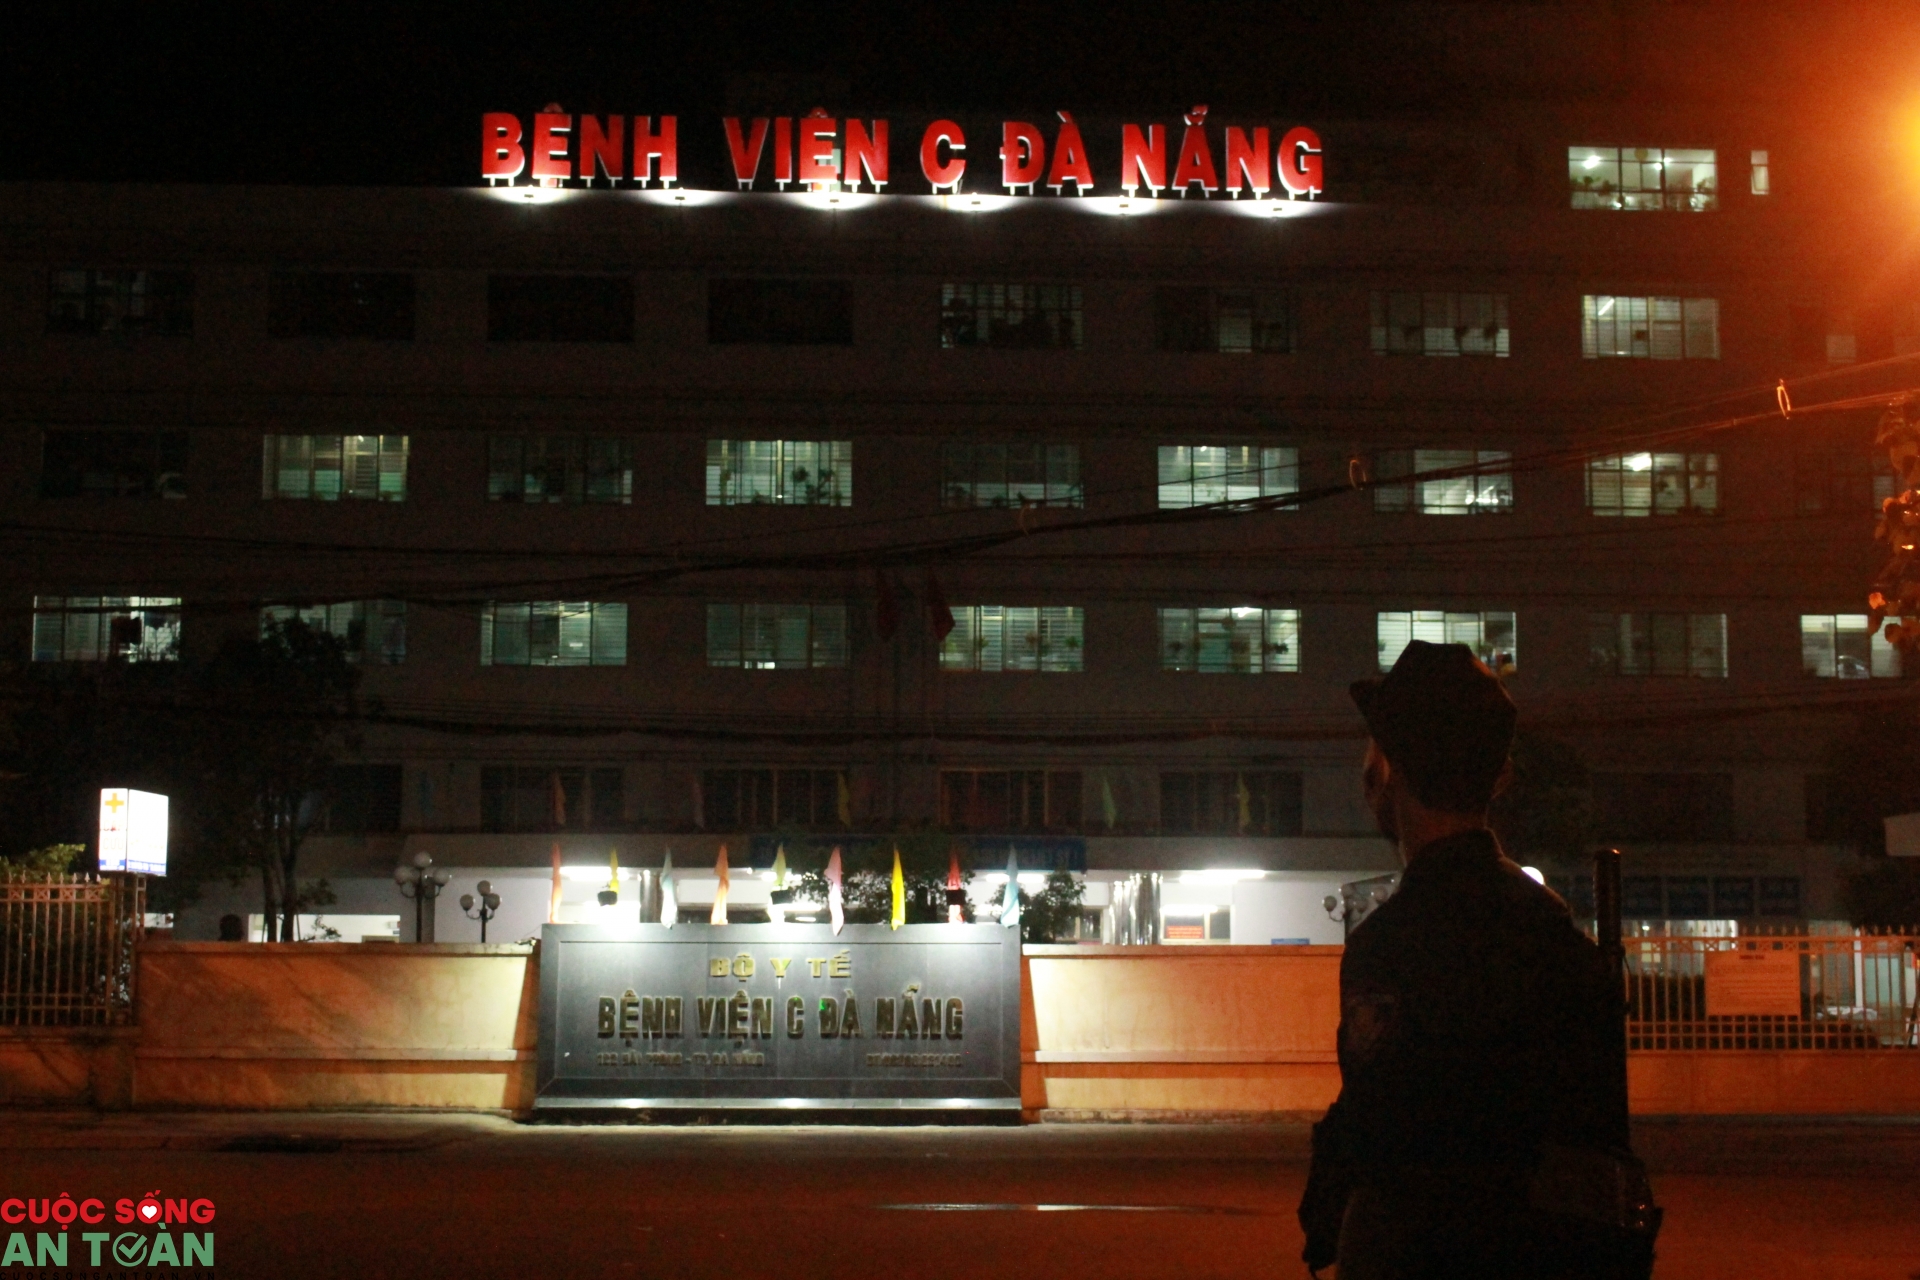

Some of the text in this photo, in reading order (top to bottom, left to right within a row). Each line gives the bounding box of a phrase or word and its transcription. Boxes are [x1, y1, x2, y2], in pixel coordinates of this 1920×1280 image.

[920, 119, 967, 189] C
[999, 111, 1094, 190] ĐÀ
[1121, 104, 1324, 194] NẴNG
[709, 949, 852, 982] BỘ Y TẾ
[597, 983, 964, 1047] BỆNH VIỆN C ĐÀ NẴNG
